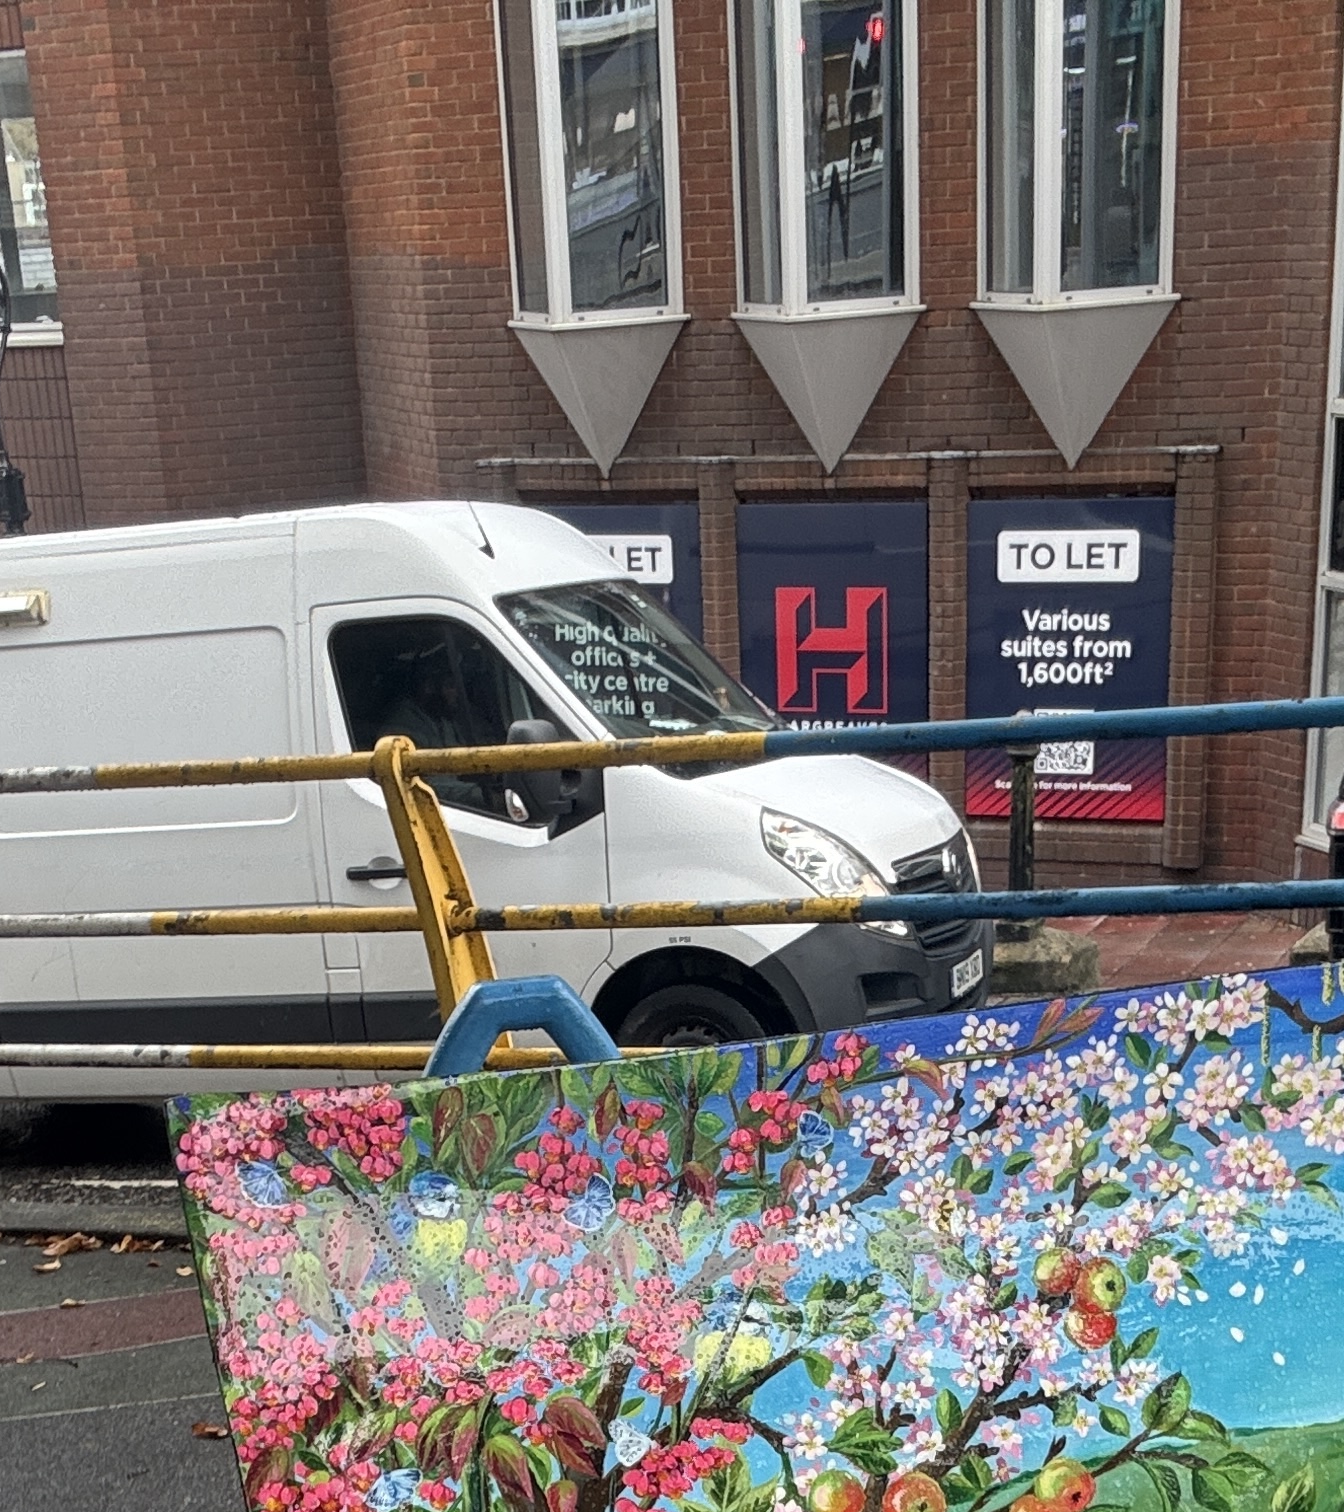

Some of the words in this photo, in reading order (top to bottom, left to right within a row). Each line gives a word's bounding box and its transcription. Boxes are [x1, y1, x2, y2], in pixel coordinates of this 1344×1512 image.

[609, 546, 662, 572] ET
[1009, 542, 1055, 570] TO
[1066, 542, 1128, 570] LET
[1022, 608, 1111, 631] Various
[555, 622, 600, 645] High
[1000, 634, 1068, 657] suites
[1072, 634, 1132, 658] from
[564, 670, 600, 694] ity
[586, 695, 656, 719] arkig
